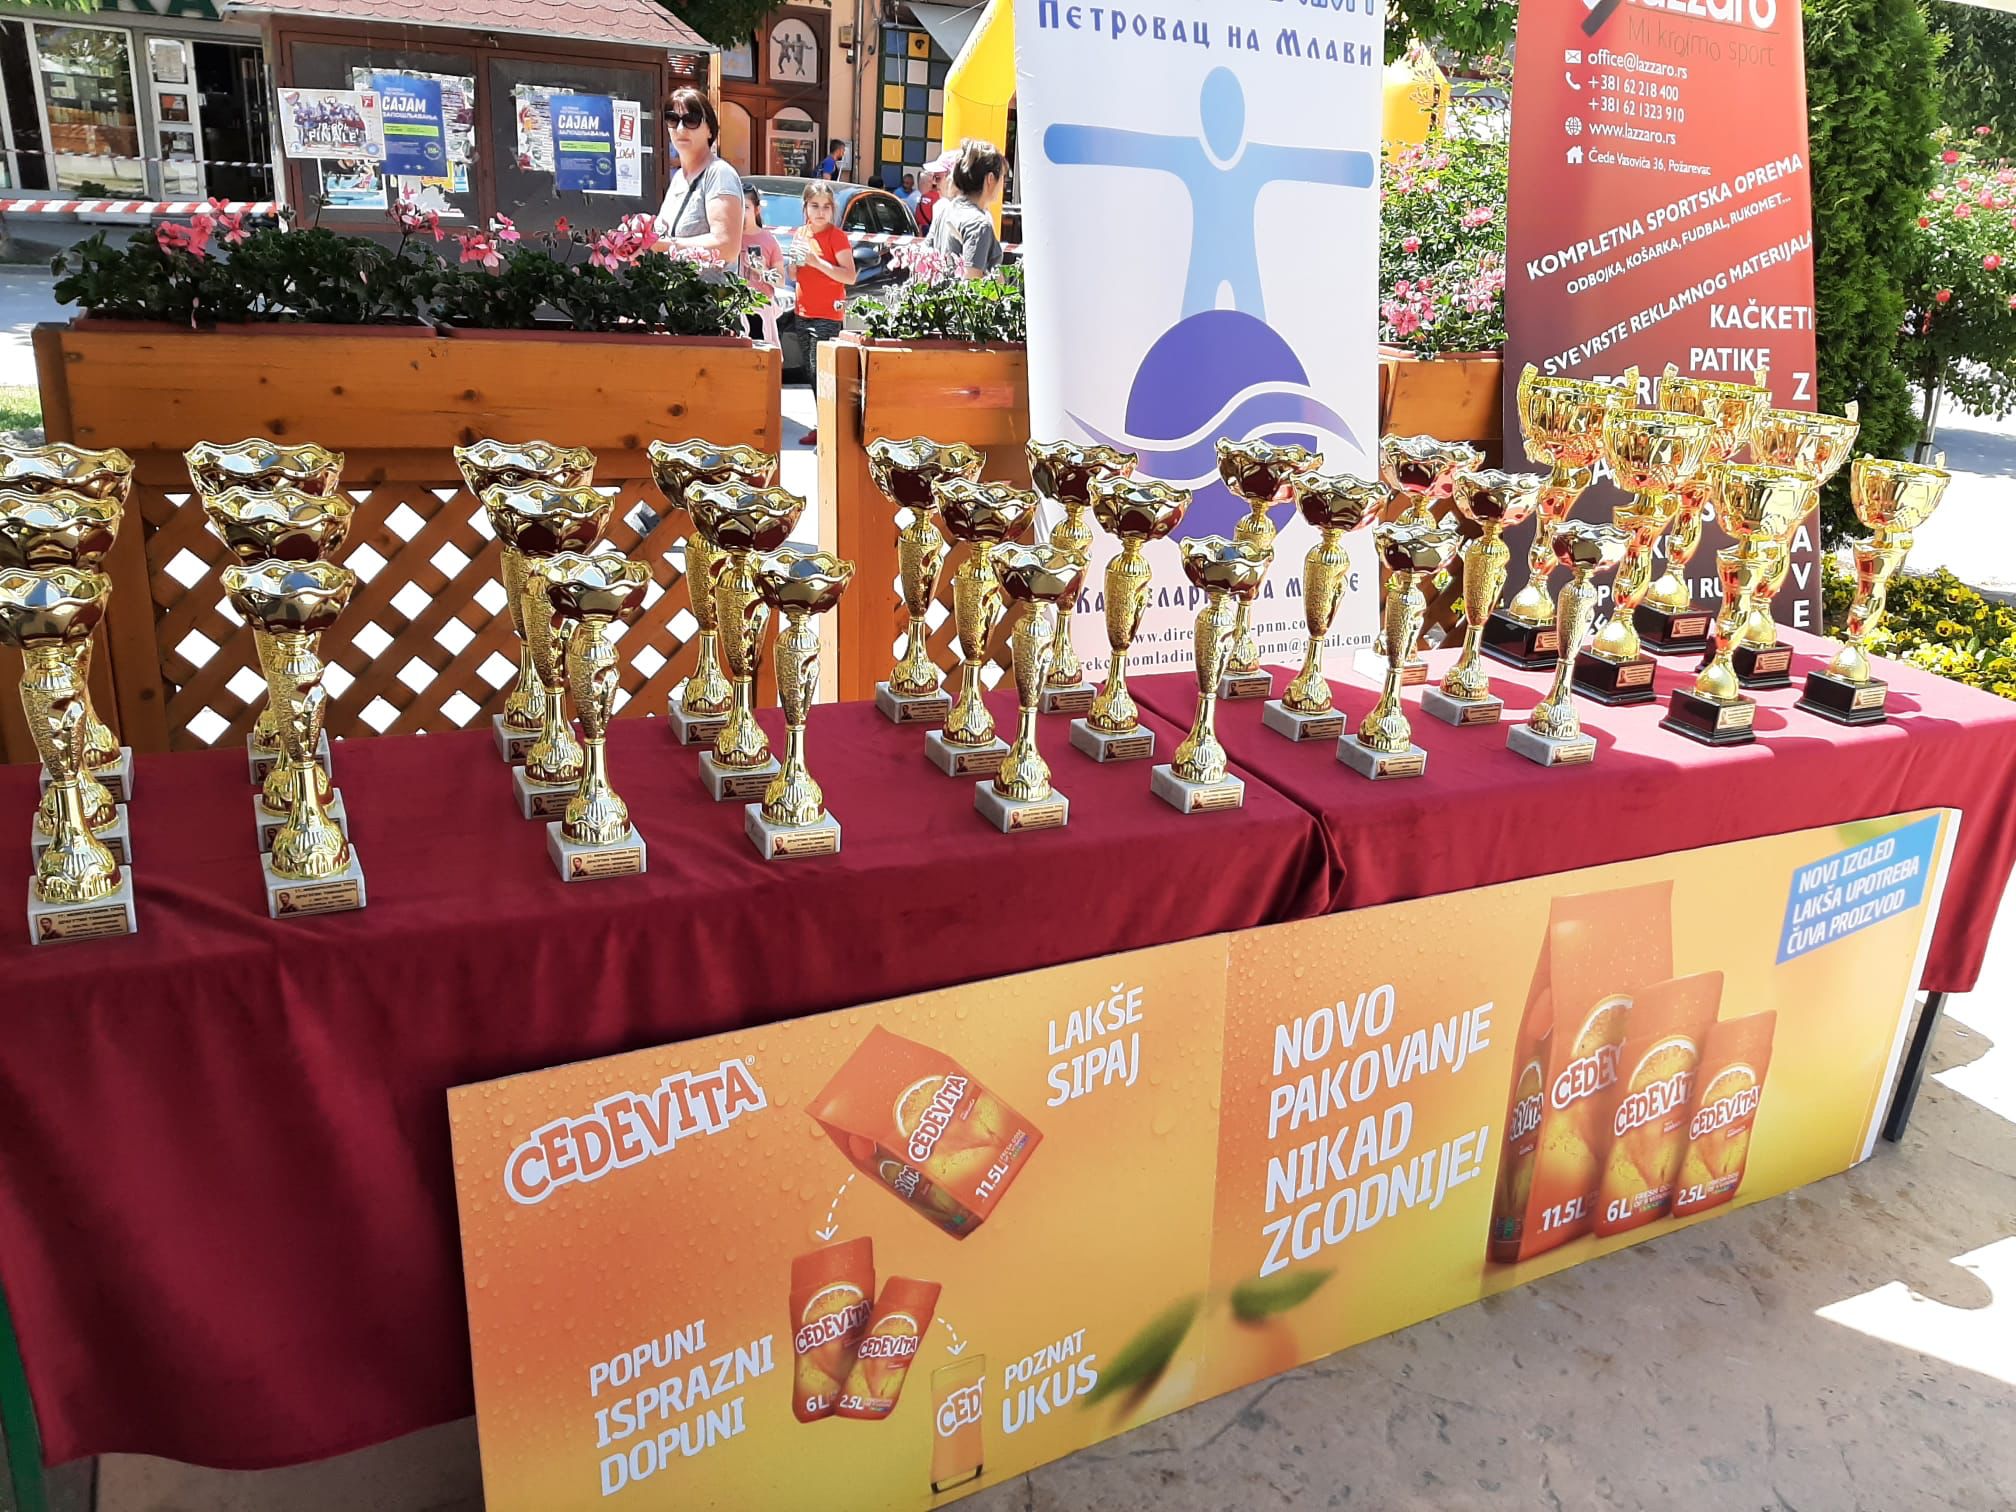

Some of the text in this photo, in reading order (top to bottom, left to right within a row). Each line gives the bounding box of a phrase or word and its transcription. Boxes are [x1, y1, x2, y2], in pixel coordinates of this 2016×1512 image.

[1038, 0, 1210, 49] Петровац
[1228, 25, 1260, 52] на
[1276, 28, 1372, 67] Млави
[1588, 49, 1688, 79] office@lazzaro.rs
[1629, 16, 1651, 45] Mi
[1728, 40, 1776, 67] sport
[1623, 79, 1635, 94] 62
[1639, 81, 1657, 98] 218
[1660, 86, 1679, 101] 400
[1623, 100, 1636, 116] 62
[1639, 102, 1663, 120] 1323
[1666, 107, 1684, 123] 910
[1588, 146, 1614, 164] Čede
[1653, 158, 1666, 171] 36,
[1589, 122, 1676, 145] www.lazzaro.rs
[1526, 153, 1803, 281] KOMPLETNA SPORTSKA OPREMA
[1566, 261, 1626, 294] ODBOJKA,
[1625, 237, 1682, 270] KOŠARKA,
[1681, 217, 1730, 245] FUDBAL,
[1543, 347, 1581, 376] SVE
[1580, 321, 1628, 359] VRSTE
[1630, 272, 1728, 334] REKLAMNOG
[1710, 298, 1812, 330] KAČKETI
[1690, 347, 1771, 372] PATIKE
[1792, 855, 1919, 925] LAKŠA UPOTREBA
[1798, 837, 1895, 894] NOVI IZGLED
[1787, 888, 1905, 954] ČUVA PROIZVOD
[1047, 983, 1145, 1057] LAKŠE
[1272, 982, 1395, 1076] NOVO
[1046, 1028, 1140, 1107] SIPAJ
[1268, 1001, 1493, 1140] PAKOVANJE
[504, 1058, 767, 1205] CEDEVITA
[909, 1073, 968, 1162] CEDEVITA
[1689, 1085, 1761, 1140] CEDEVITA
[975, 1160, 1009, 1199] 11.5L
[1266, 1101, 1414, 1213] NIKAD
[1260, 1126, 1489, 1278] ZGODNIJE!
[1542, 1197, 1587, 1232] 11.5L
[1607, 1197, 1632, 1222] 6L
[589, 1318, 707, 1396] POPUNI
[796, 1298, 874, 1354] CEDEVITA
[858, 1335, 919, 1359] CEDEVITA
[595, 1334, 776, 1448] ISPRAZNI
[1004, 1329, 1086, 1391] POZNAT
[806, 1395, 829, 1412] 6L
[1001, 1354, 1099, 1435] UKUS
[600, 1396, 747, 1496] DOPUNI
